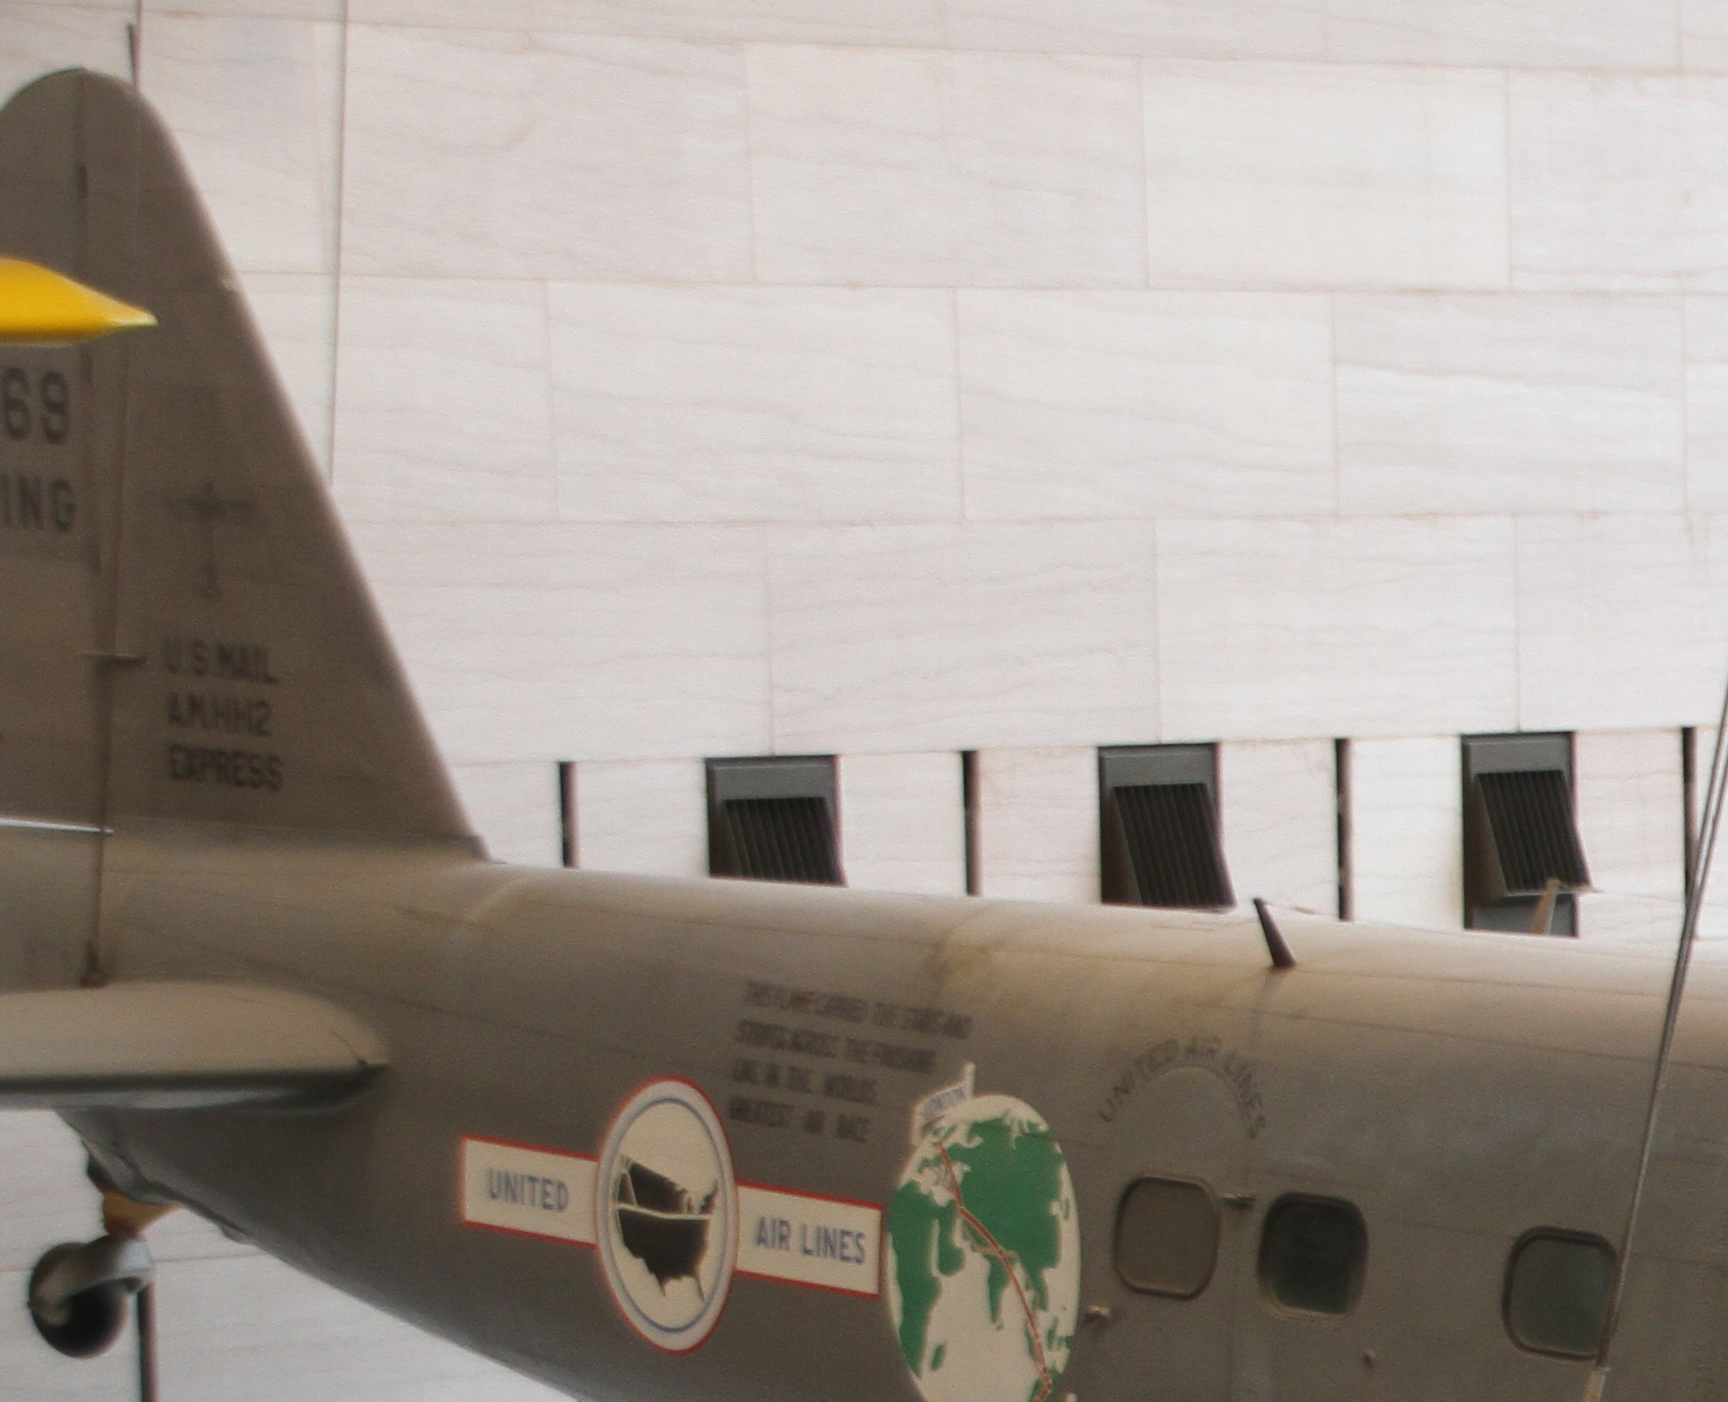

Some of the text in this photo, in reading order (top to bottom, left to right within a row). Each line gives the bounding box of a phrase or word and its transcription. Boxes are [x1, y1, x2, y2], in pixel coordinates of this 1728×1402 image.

[167, 742, 285, 792] EXPRESS
[485, 1168, 569, 1213] UNITED
[755, 1216, 868, 1264] AIR LINES
